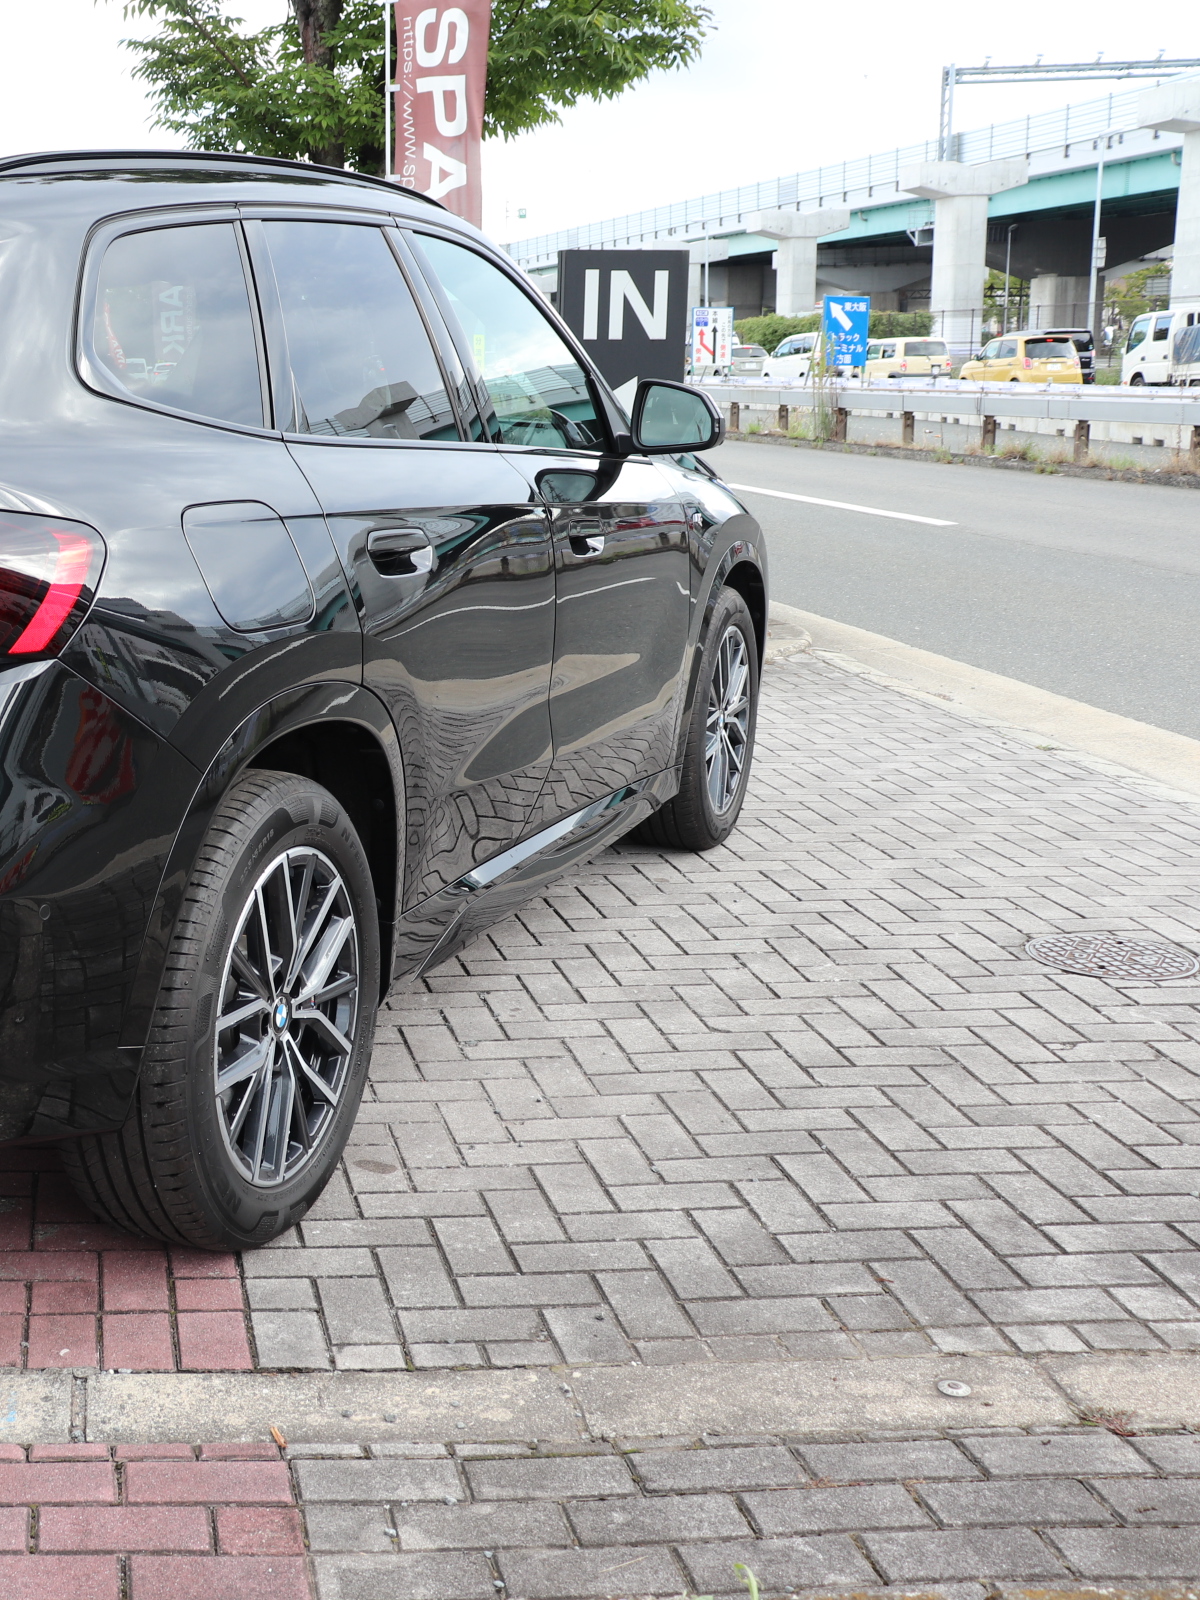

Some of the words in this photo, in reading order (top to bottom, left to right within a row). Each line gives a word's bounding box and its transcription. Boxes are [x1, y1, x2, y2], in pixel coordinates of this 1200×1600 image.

[583, 269, 669, 340] IN
[844, 302, 867, 312] 東大阪
[836, 354, 852, 364] 方面
